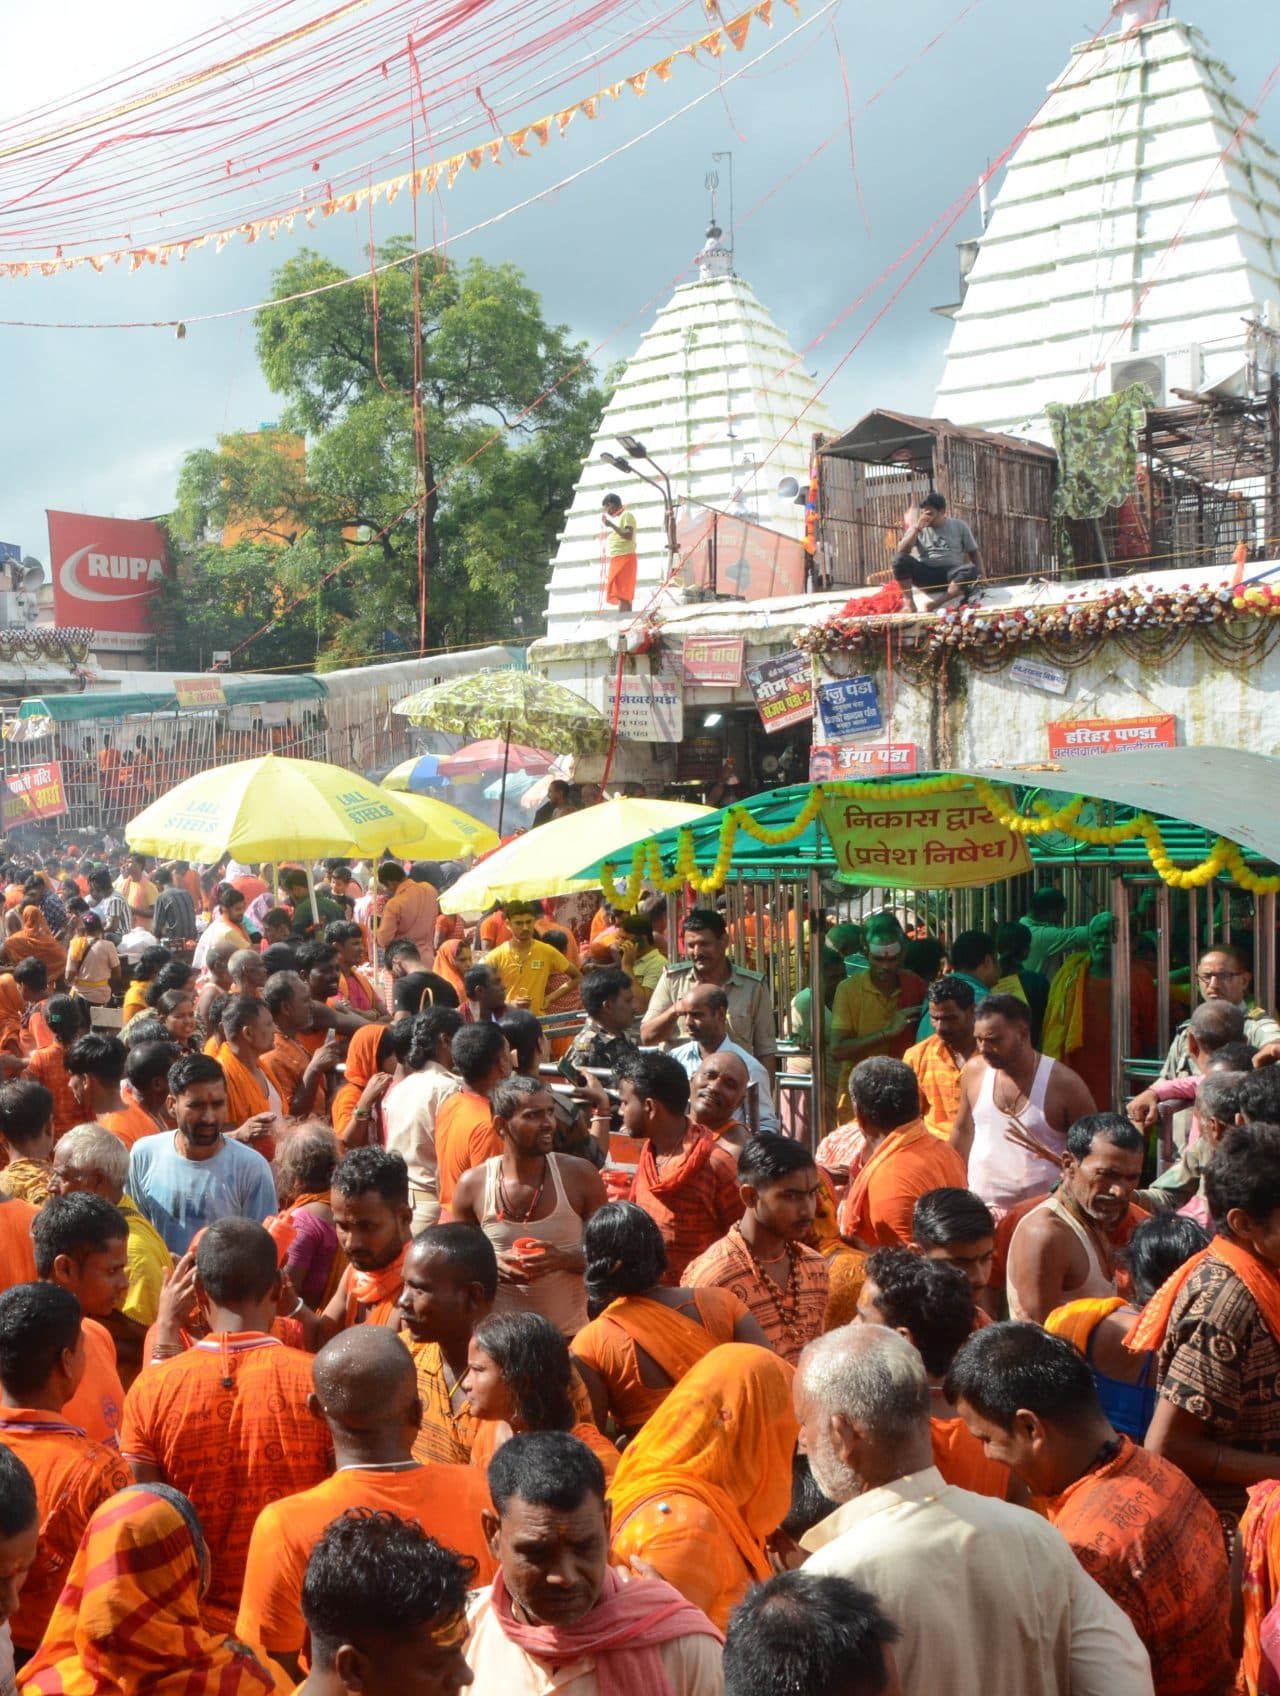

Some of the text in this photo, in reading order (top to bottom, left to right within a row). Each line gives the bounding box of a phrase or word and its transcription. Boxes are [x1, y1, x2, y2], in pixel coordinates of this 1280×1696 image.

[87, 553, 165, 582] RUPA
[756, 666, 812, 699] भीम पंड
[846, 679, 873, 696] पंडा
[1063, 726, 1159, 744] हरिहर पण्डा
[877, 746, 911, 763] पंडा
[336, 790, 370, 806] LALL
[347, 804, 395, 825] STEELS
[844, 804, 996, 831] निकास द्वार
[844, 831, 1019, 868] (प्रवेश निषेध)
